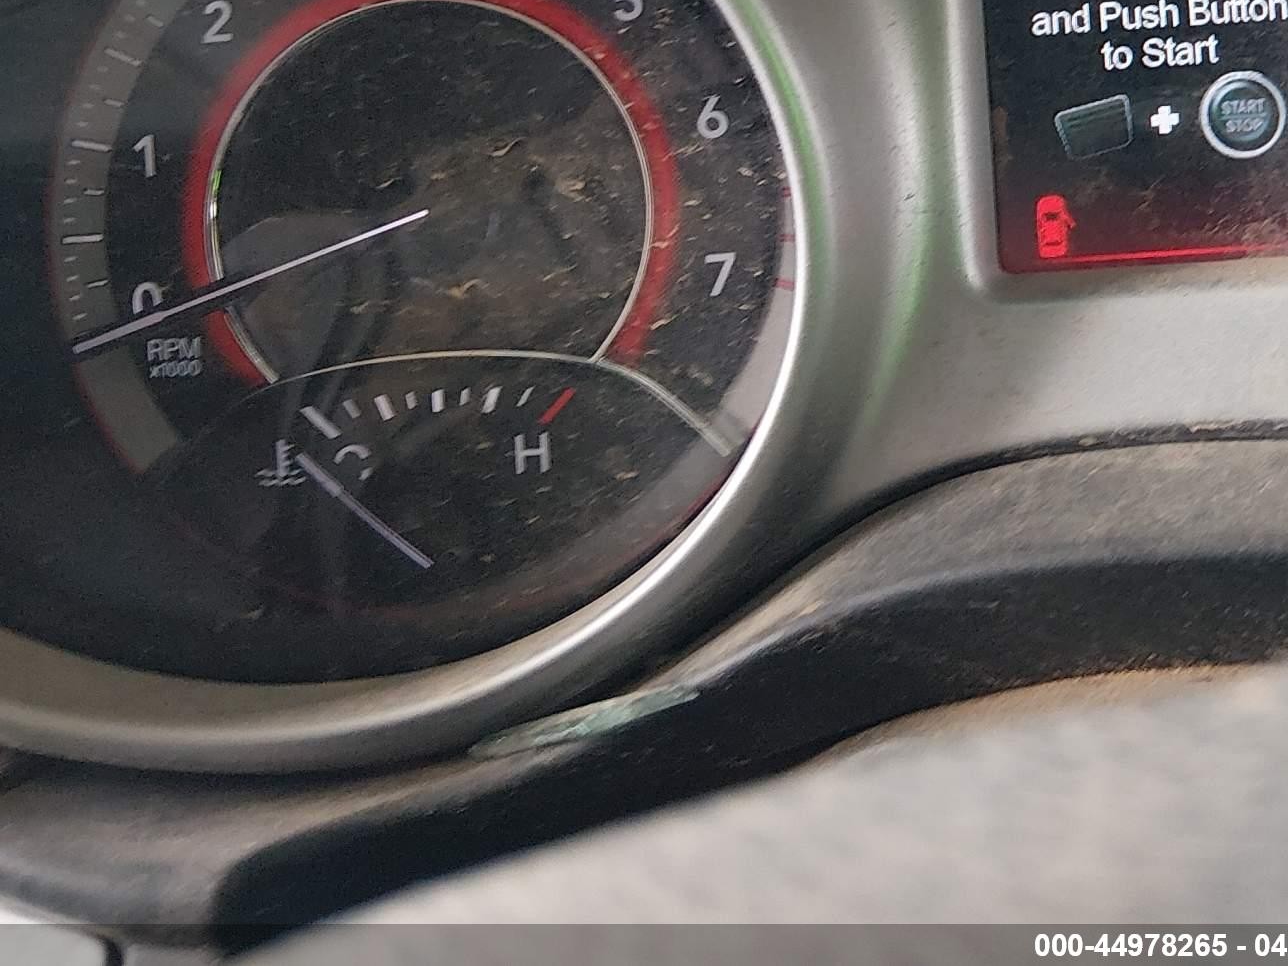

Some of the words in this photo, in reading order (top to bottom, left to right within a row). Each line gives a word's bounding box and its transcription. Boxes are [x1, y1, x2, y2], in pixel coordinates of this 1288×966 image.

[203, 0, 233, 44] 2
[1031, 2, 1090, 36] and
[1100, 0, 1180, 31] Push
[1101, 43, 1134, 71] to
[1142, 35, 1219, 68] Start
[697, 96, 729, 139] 6
[1221, 97, 1266, 115] START
[1226, 117, 1263, 133] STOP
[133, 135, 157, 177] 1
[704, 253, 735, 298] 7
[146, 337, 201, 362] RPM
[514, 434, 551, 474] H
